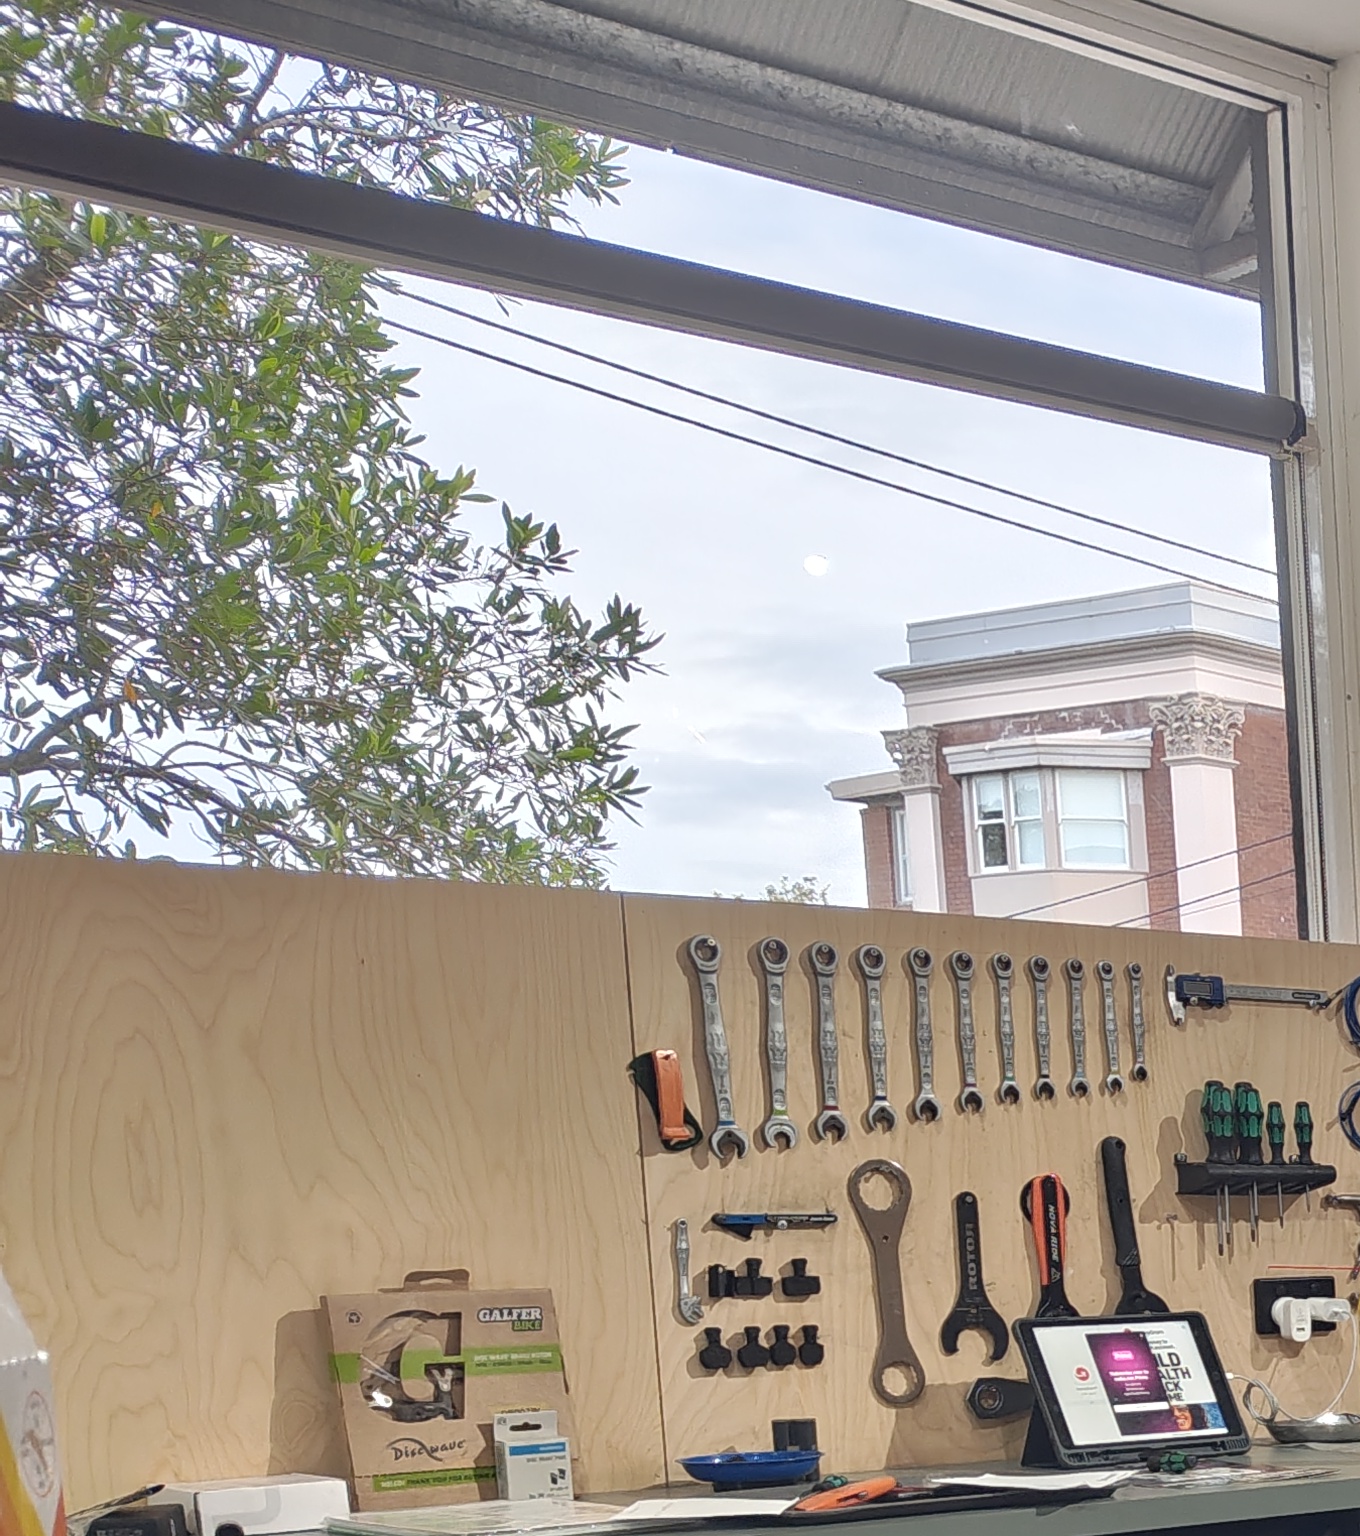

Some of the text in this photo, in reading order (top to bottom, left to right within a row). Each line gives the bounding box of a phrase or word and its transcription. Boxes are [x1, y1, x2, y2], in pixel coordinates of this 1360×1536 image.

[1048, 1204, 1059, 1263] NOVA RIDE
[964, 1223, 978, 1290] ROTOR
[478, 1308, 543, 1322] GALFER
[513, 1320, 542, 1331] BIKE
